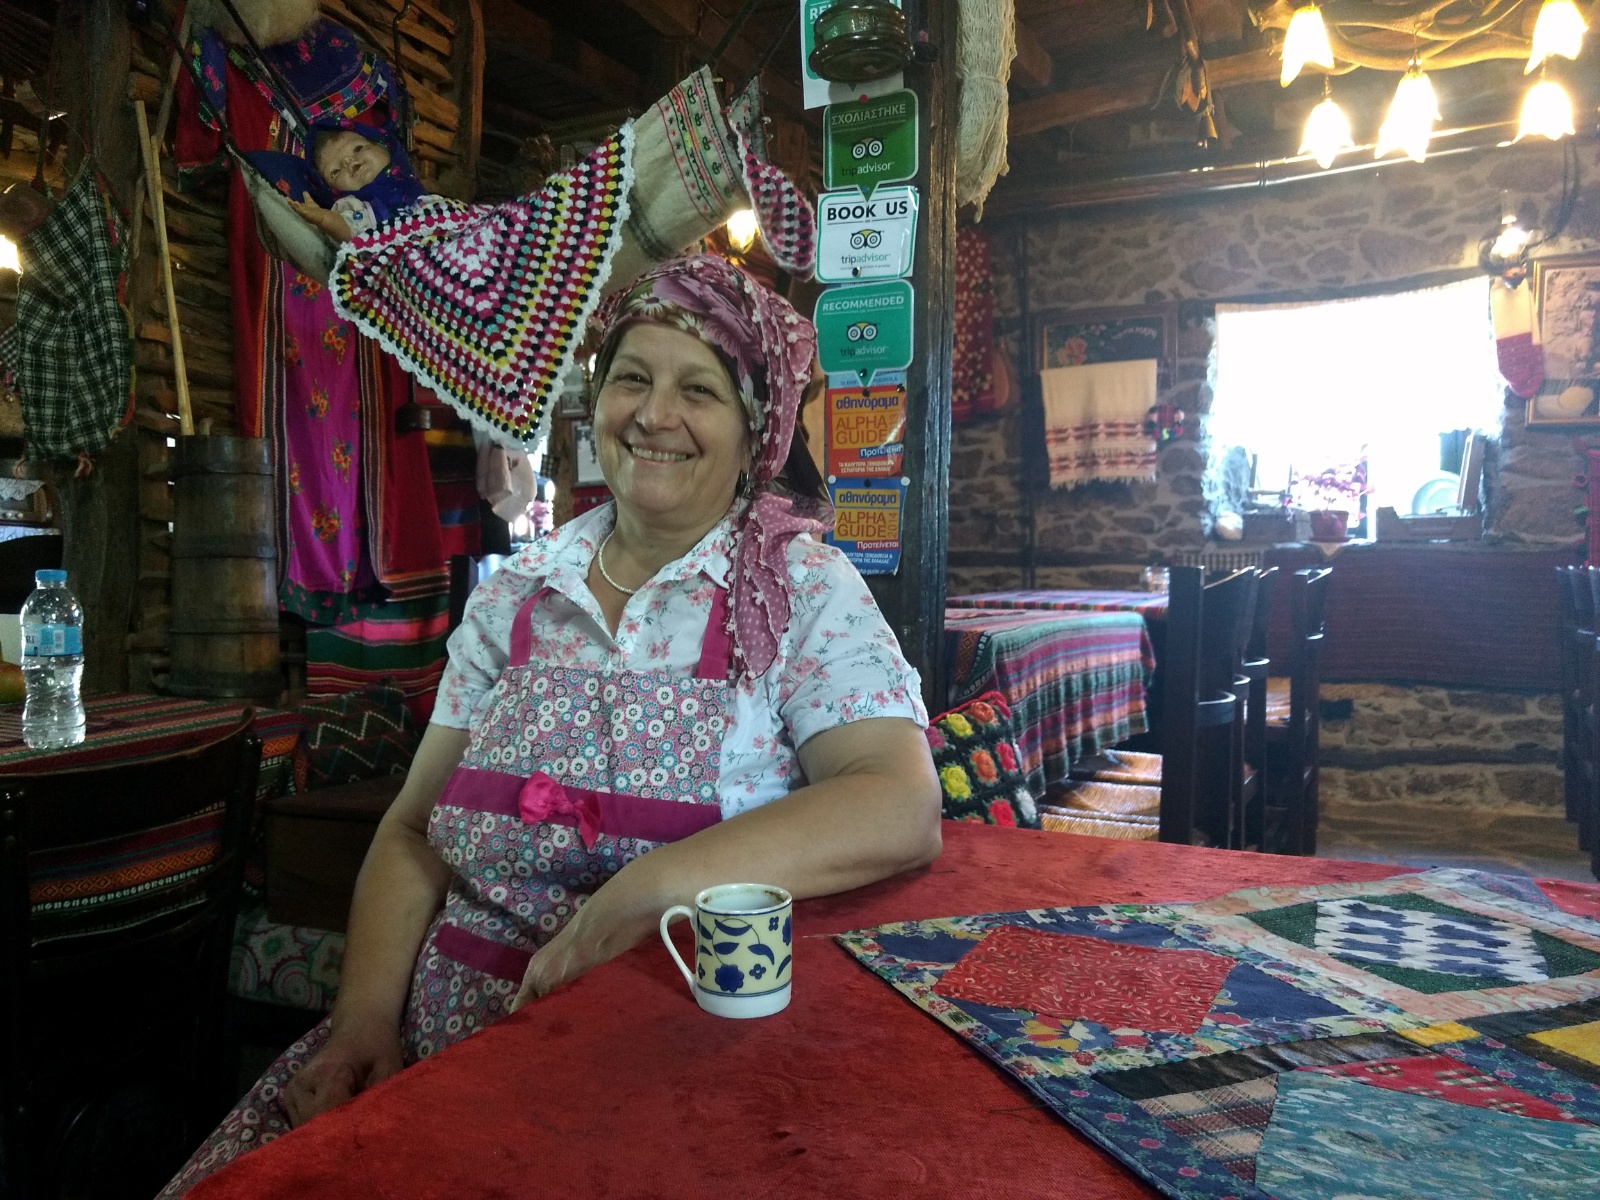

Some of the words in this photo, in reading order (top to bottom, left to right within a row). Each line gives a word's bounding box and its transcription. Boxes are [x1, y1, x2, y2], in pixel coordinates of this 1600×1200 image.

[831, 103, 906, 126] ΣΧΟΛΙΑΣΤΗΚΕ
[841, 161, 892, 177] tripadvisor
[827, 203, 877, 221] BOOK
[886, 200, 908, 216] US
[841, 253, 888, 265] tripadvisor
[822, 295, 904, 312] RECOMMENDED
[840, 345, 887, 357] tripadvisor
[836, 415, 888, 431] ALPHA
[836, 429, 887, 445] GUIDE
[838, 491, 897, 506] αθηνόραμα
[838, 511, 886, 525] ALPHA
[888, 512, 898, 538] 2014
[837, 524, 886, 538] GUIDE
[857, 541, 899, 550] Προτείνεται
